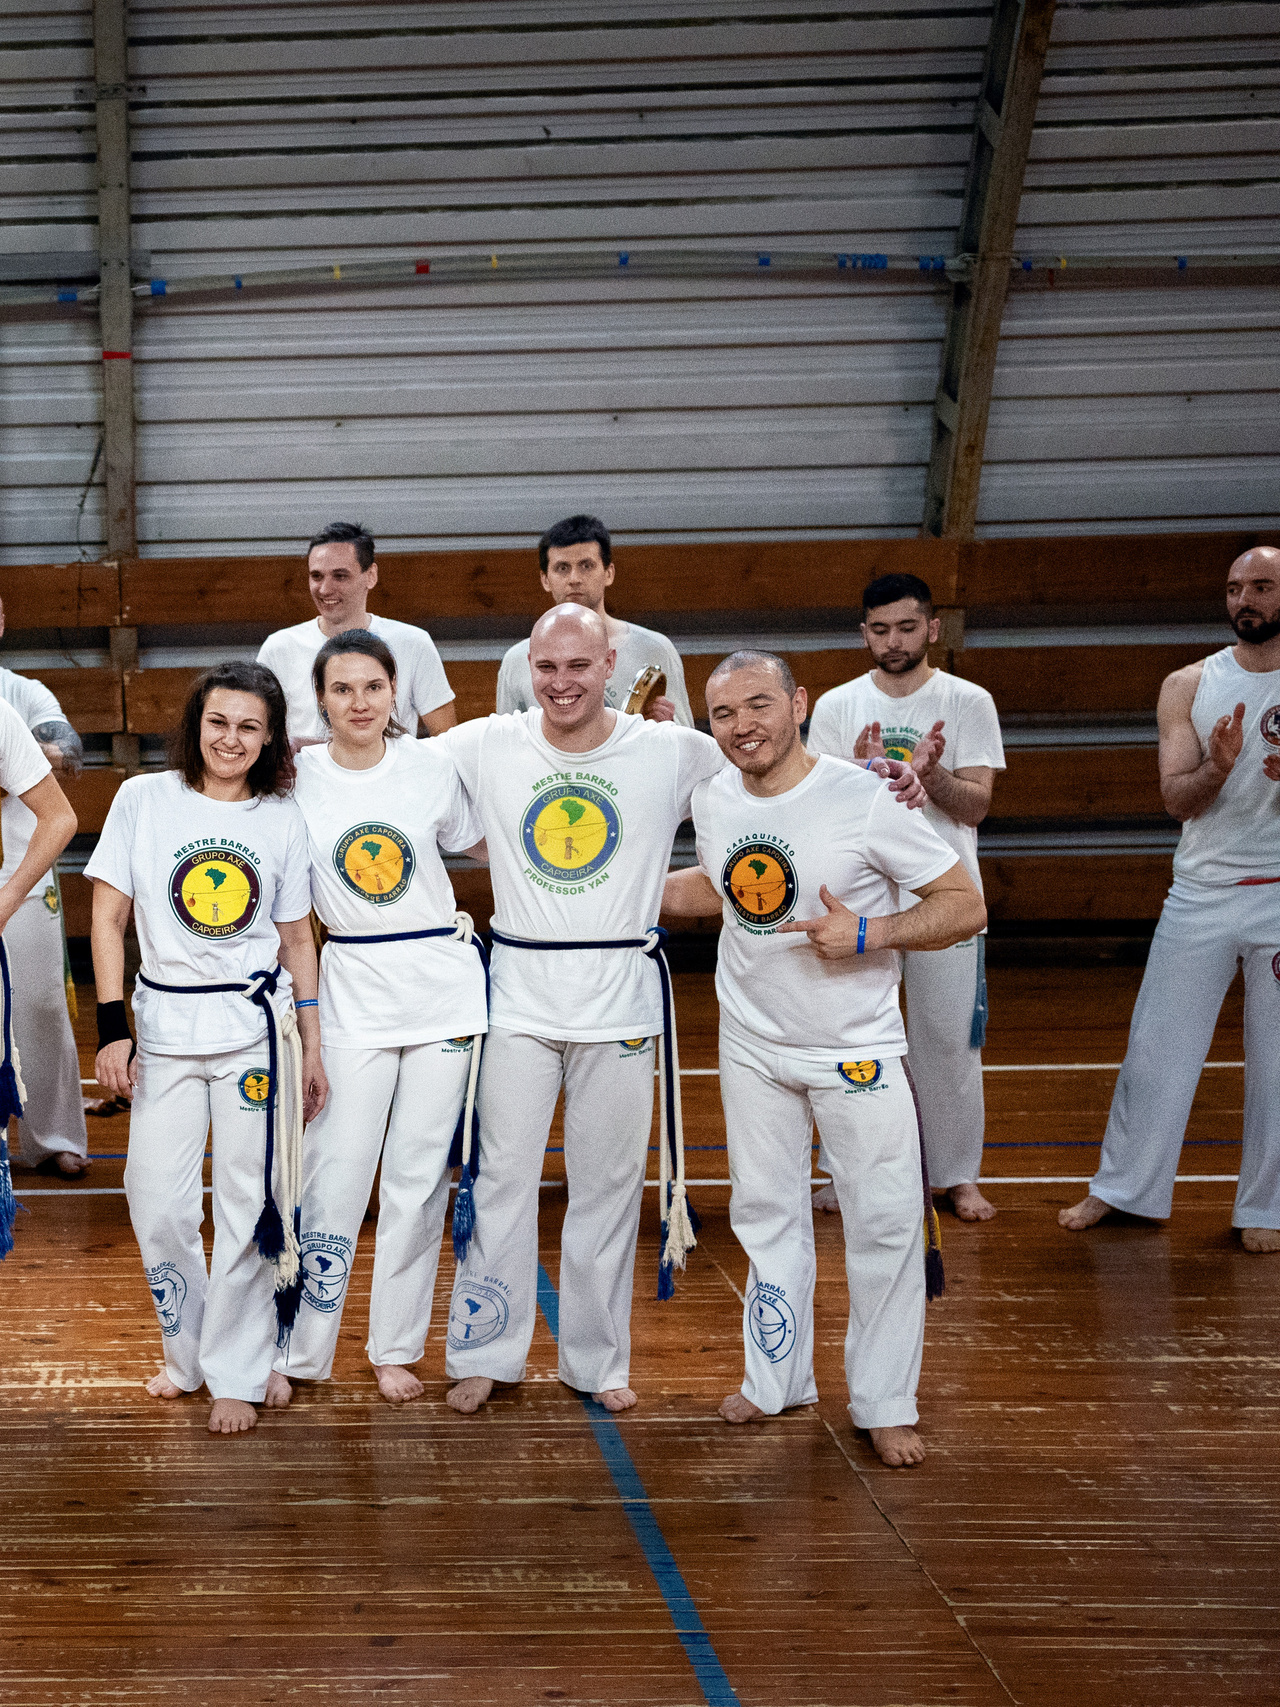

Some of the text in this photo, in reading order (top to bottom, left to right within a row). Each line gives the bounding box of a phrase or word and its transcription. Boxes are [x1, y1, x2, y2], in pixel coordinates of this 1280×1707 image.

[575, 772, 619, 797] BARRÃO
[542, 787, 581, 804] GRUPO
[173, 838, 261, 865] MESTRE BARRÃO
[337, 835, 354, 859] GRUPO
[372, 826, 407, 850] CAPOEIRA
[191, 851, 226, 865] GRUPO
[726, 851, 744, 873] GRUPO
[761, 846, 790, 873] CAPOEIRA
[541, 862, 595, 879] CAPOEIRA
[383, 878, 407, 901] BARRÃO
[523, 867, 610, 896] PROFESSOR YAN
[734, 902, 759, 923] MESTRE
[191, 922, 237, 936] CAPOEIRA
[301, 1231, 327, 1241] MESTRE
[758, 1281, 786, 1297] ARRÃO
